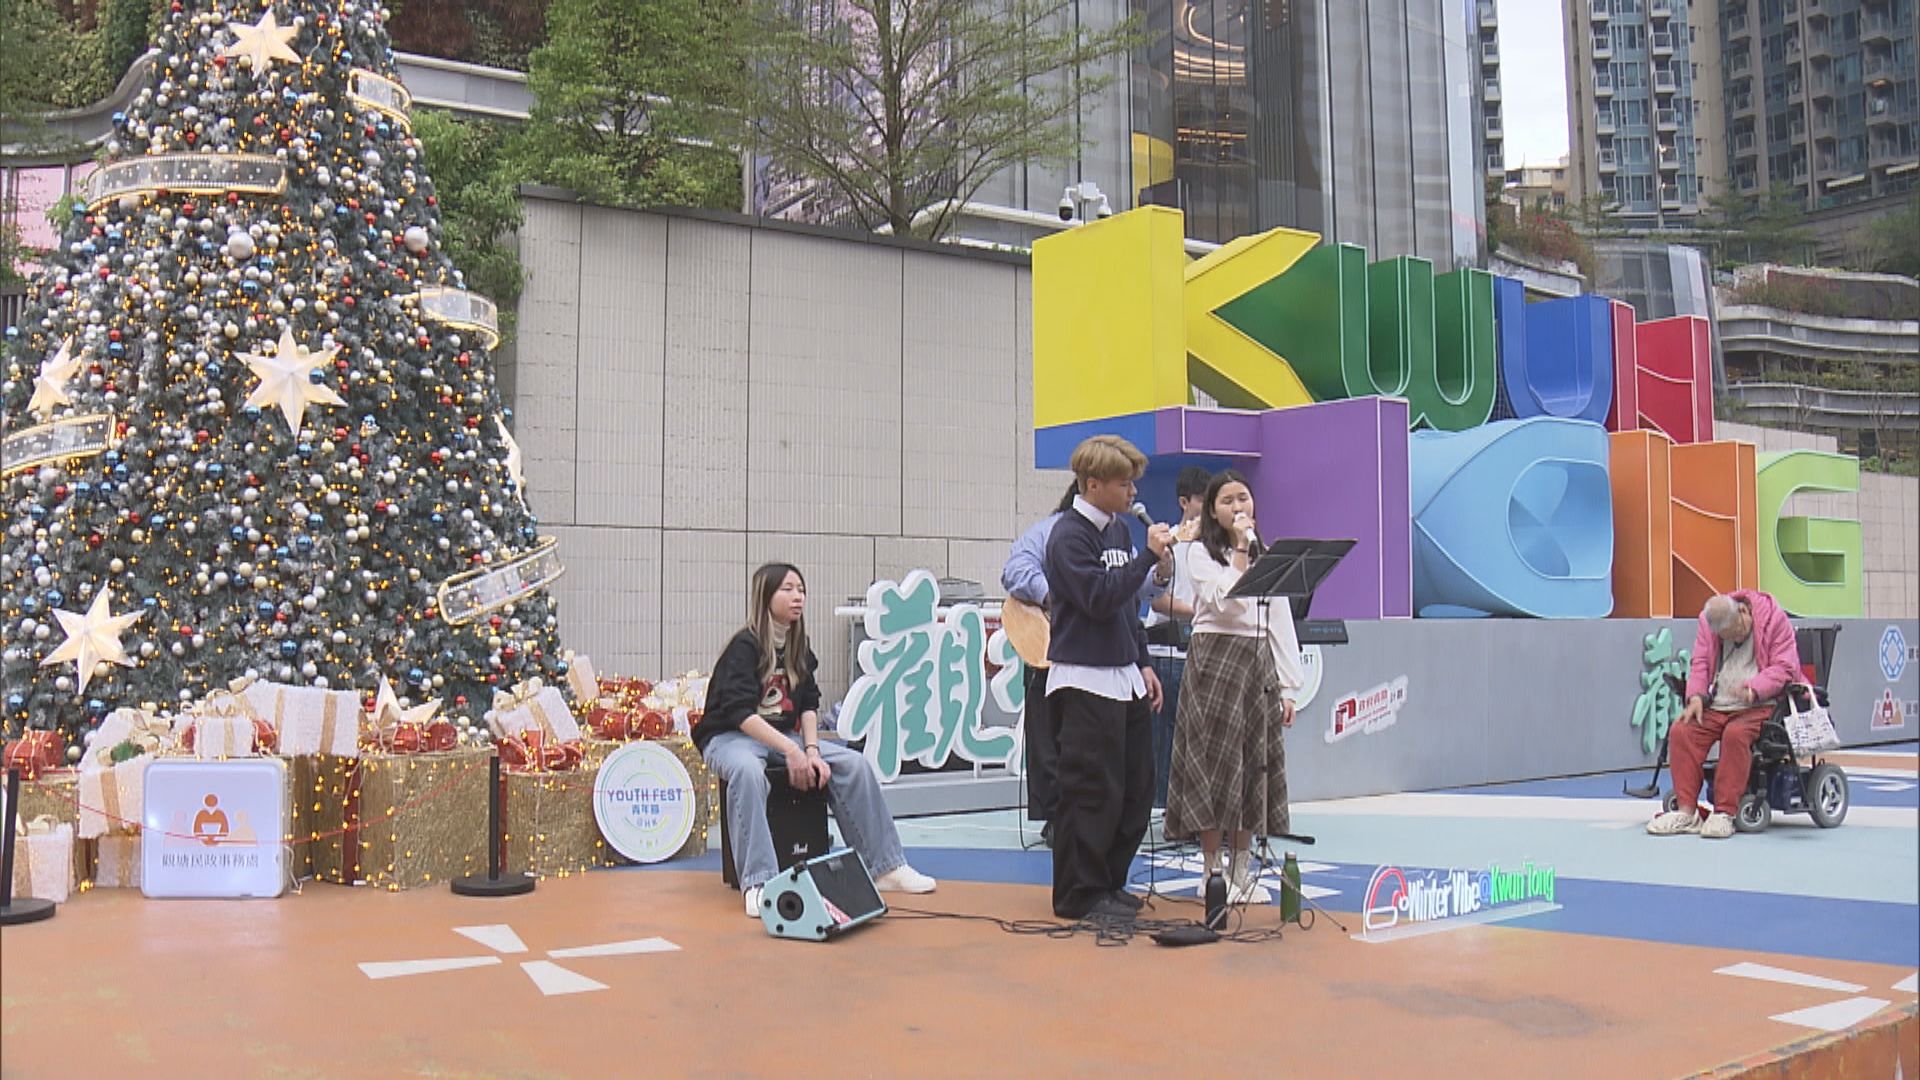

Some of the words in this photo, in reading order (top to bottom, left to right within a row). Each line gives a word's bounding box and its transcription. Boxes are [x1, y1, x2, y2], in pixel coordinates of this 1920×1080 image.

[1034, 205, 1712, 443] KWUN
[1155, 395, 1864, 620] TONG
[607, 788, 649, 802] YOUTH
[652, 788, 683, 802] FEST
